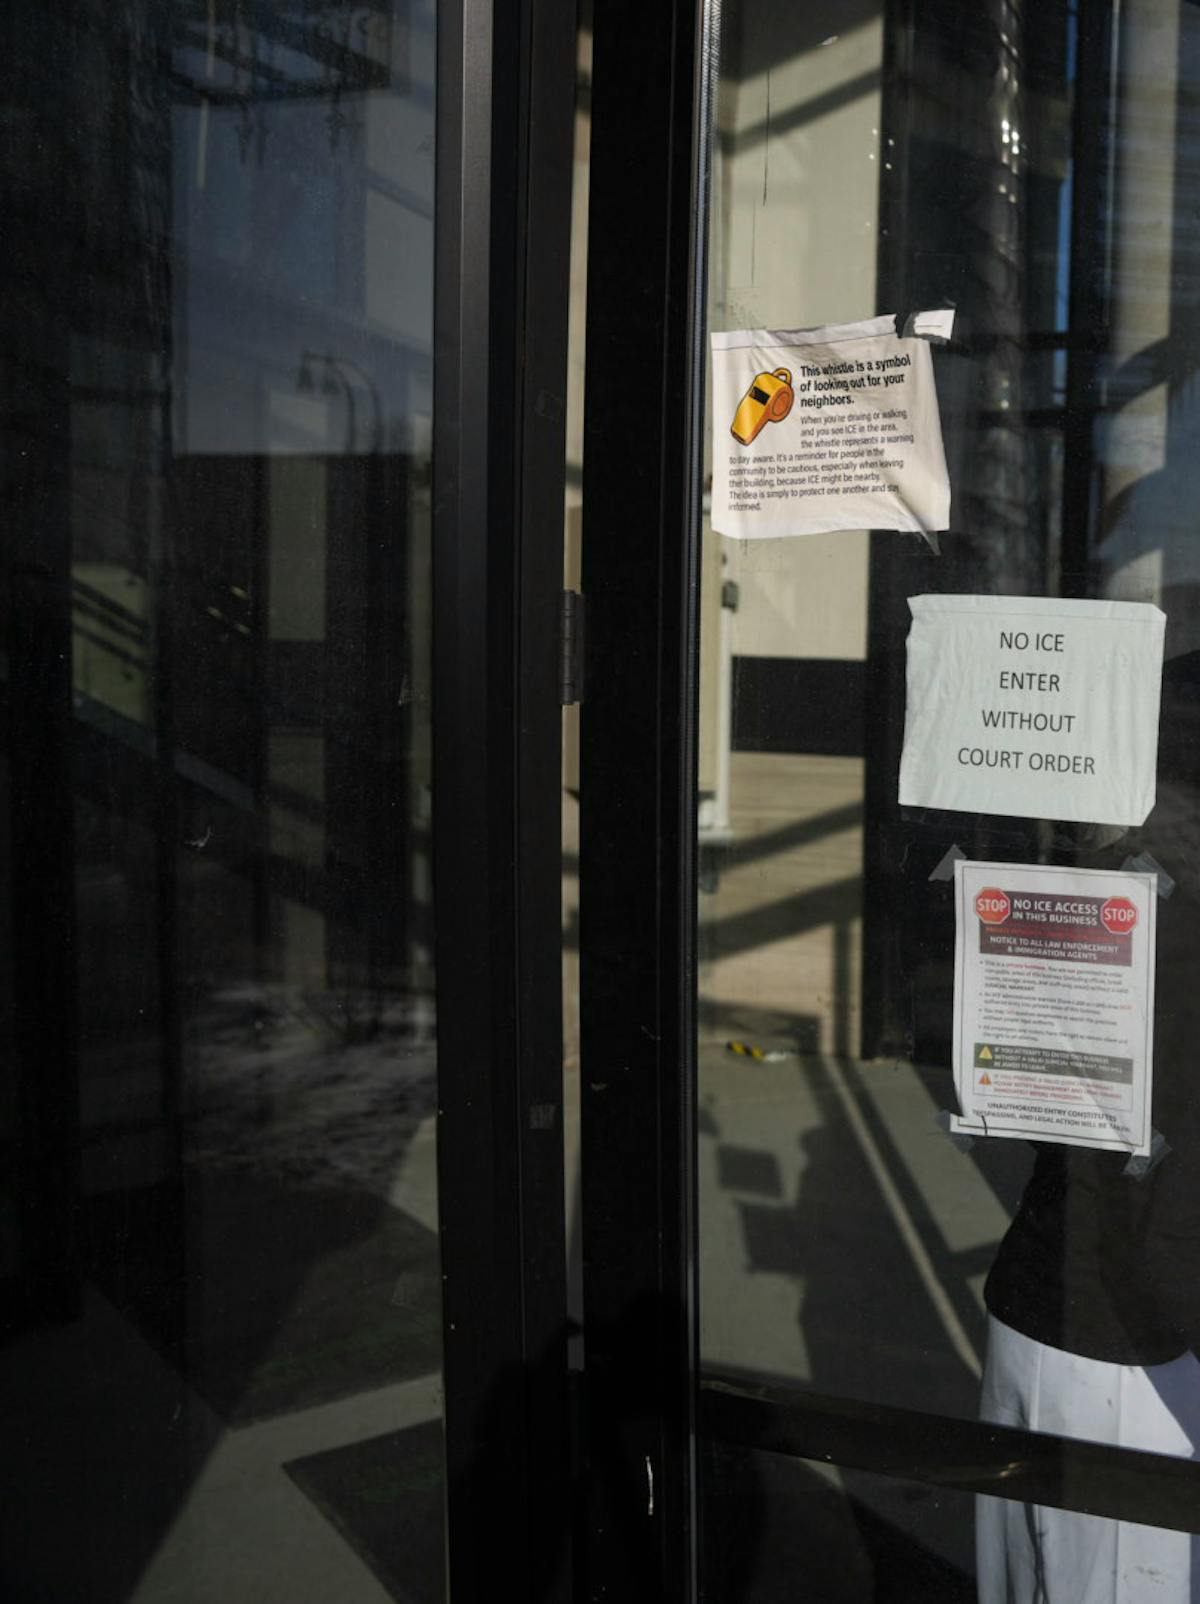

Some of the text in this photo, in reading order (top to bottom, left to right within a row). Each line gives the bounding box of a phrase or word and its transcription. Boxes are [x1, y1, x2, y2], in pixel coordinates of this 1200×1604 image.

[800, 354, 911, 378] This whistle is a symbol
[800, 373, 905, 392] of looking out for your
[800, 395, 855, 409] neighbors.
[800, 415, 821, 424] When
[847, 413, 871, 423] driving
[881, 409, 908, 420] walking
[800, 428, 814, 437] and
[816, 428, 829, 437] you
[831, 426, 844, 434] see
[845, 425, 857, 433] ICE
[867, 423, 879, 432] the
[801, 440, 813, 449] the
[815, 438, 840, 448] whistle
[841, 436, 878, 446] represents
[887, 434, 914, 444] warning
[776, 453, 787, 462] It's
[795, 452, 827, 461] reminder
[829, 450, 839, 458] for
[840, 449, 865, 460] people
[729, 466, 766, 478] community
[768, 466, 776, 474] to
[777, 465, 785, 474] be
[821, 461, 857, 472] especially
[859, 460, 879, 469] when
[880, 459, 904, 470] leaving
[776, 477, 806, 486] because
[808, 475, 819, 484] ICE
[821, 473, 842, 485] might
[843, 473, 853, 481] be
[729, 491, 741, 500] The
[759, 491, 765, 499] is
[766, 489, 790, 499] simply
[790, 489, 798, 497] to
[799, 487, 826, 499] protect
[827, 486, 840, 495] one
[842, 485, 869, 494] another
[872, 483, 886, 492] and
[1000, 632, 1065, 652] NO ICE
[999, 671, 1060, 692] ENTER
[982, 709, 1076, 733] WITHOUT
[957, 747, 1095, 775] COURT ORDER
[976, 898, 1007, 912] STOP
[1013, 899, 1098, 916] NO ICE ACCESS
[1012, 911, 1098, 926] IN THIS BUSINESS
[1104, 908, 1135, 921] STOP
[990, 936, 1120, 953] NOTICE TO ALL LAW ENFORCEMENT
[1014, 946, 1065, 958] IMMIGRATION
[1067, 950, 1098, 961] AGENTS
[987, 1103, 1117, 1122] UNAUTHORIZED ENTRY CONSTITUTES
[1035, 1115, 1054, 1123] LEGAL
[1055, 1118, 1080, 1126] ACTION
